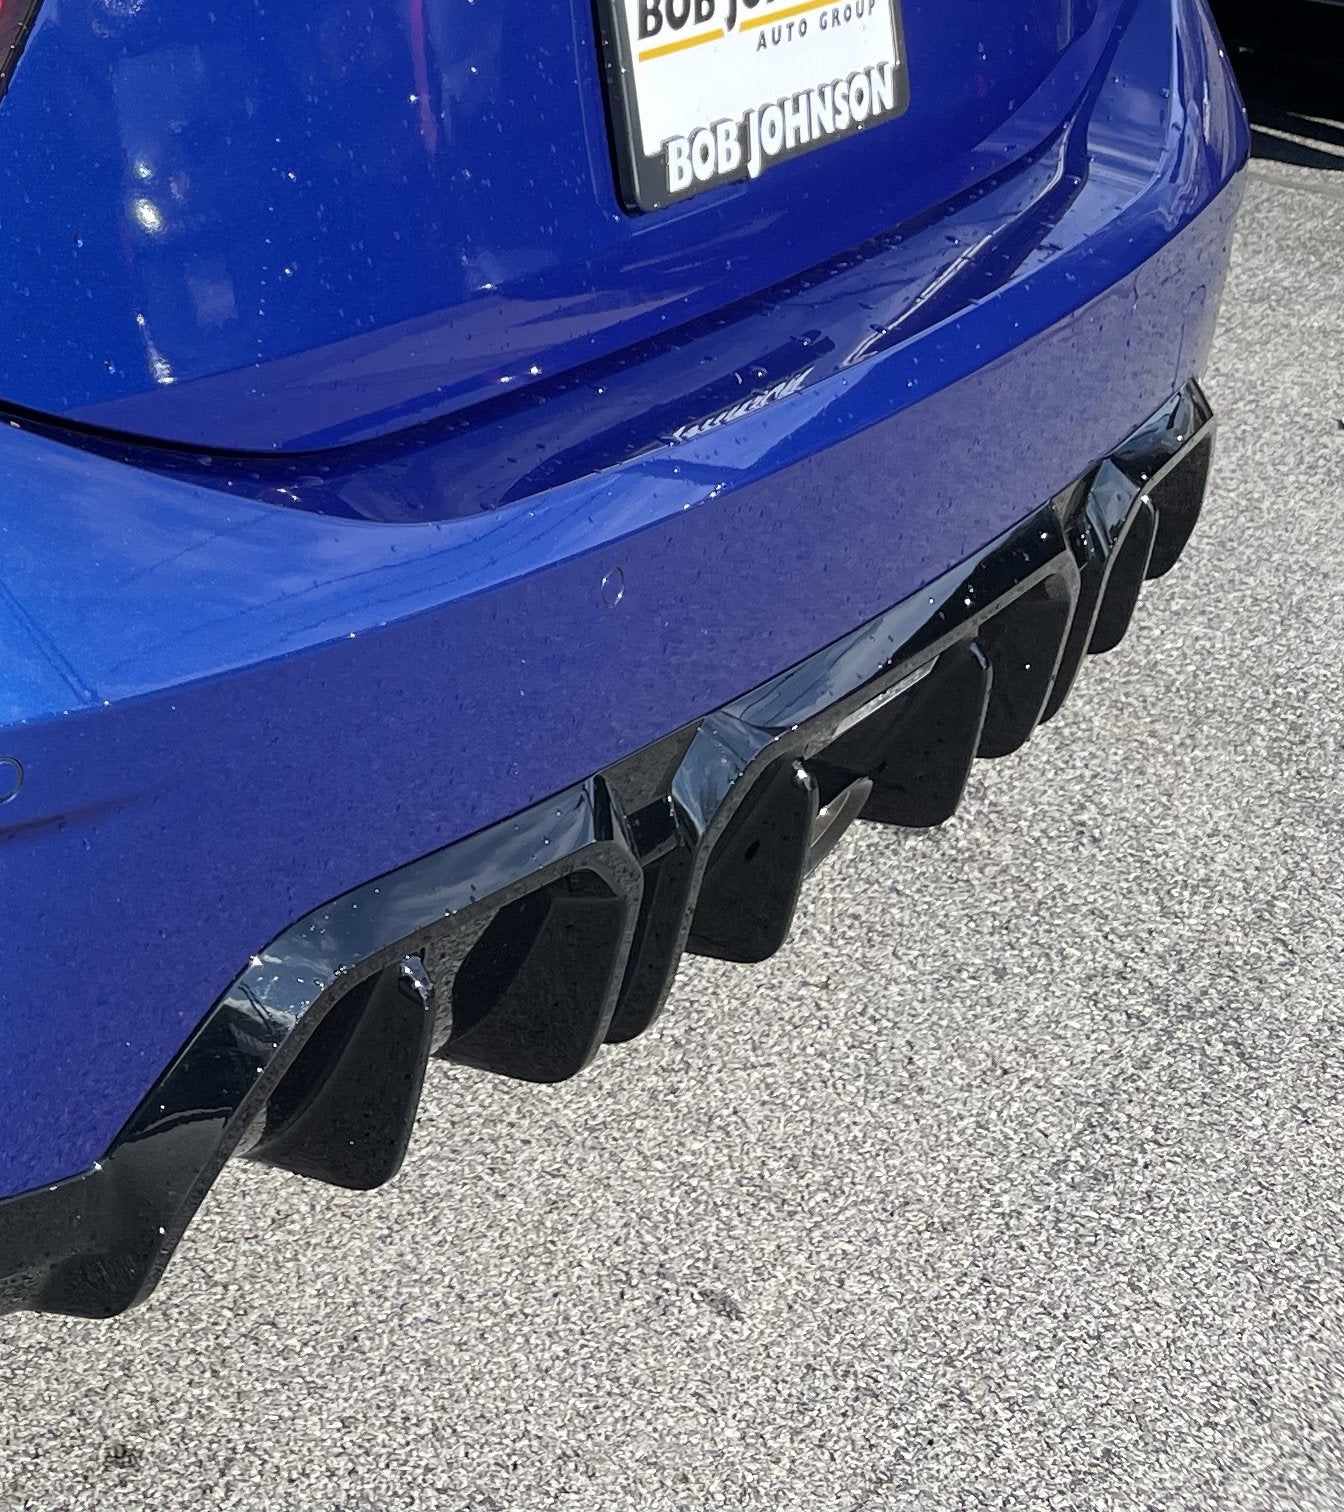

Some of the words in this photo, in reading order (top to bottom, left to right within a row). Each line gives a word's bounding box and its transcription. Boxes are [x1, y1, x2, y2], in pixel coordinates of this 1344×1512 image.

[756, 17, 809, 52] AUTO
[665, 118, 744, 194] BOB
[744, 62, 896, 180] JOHNSON
